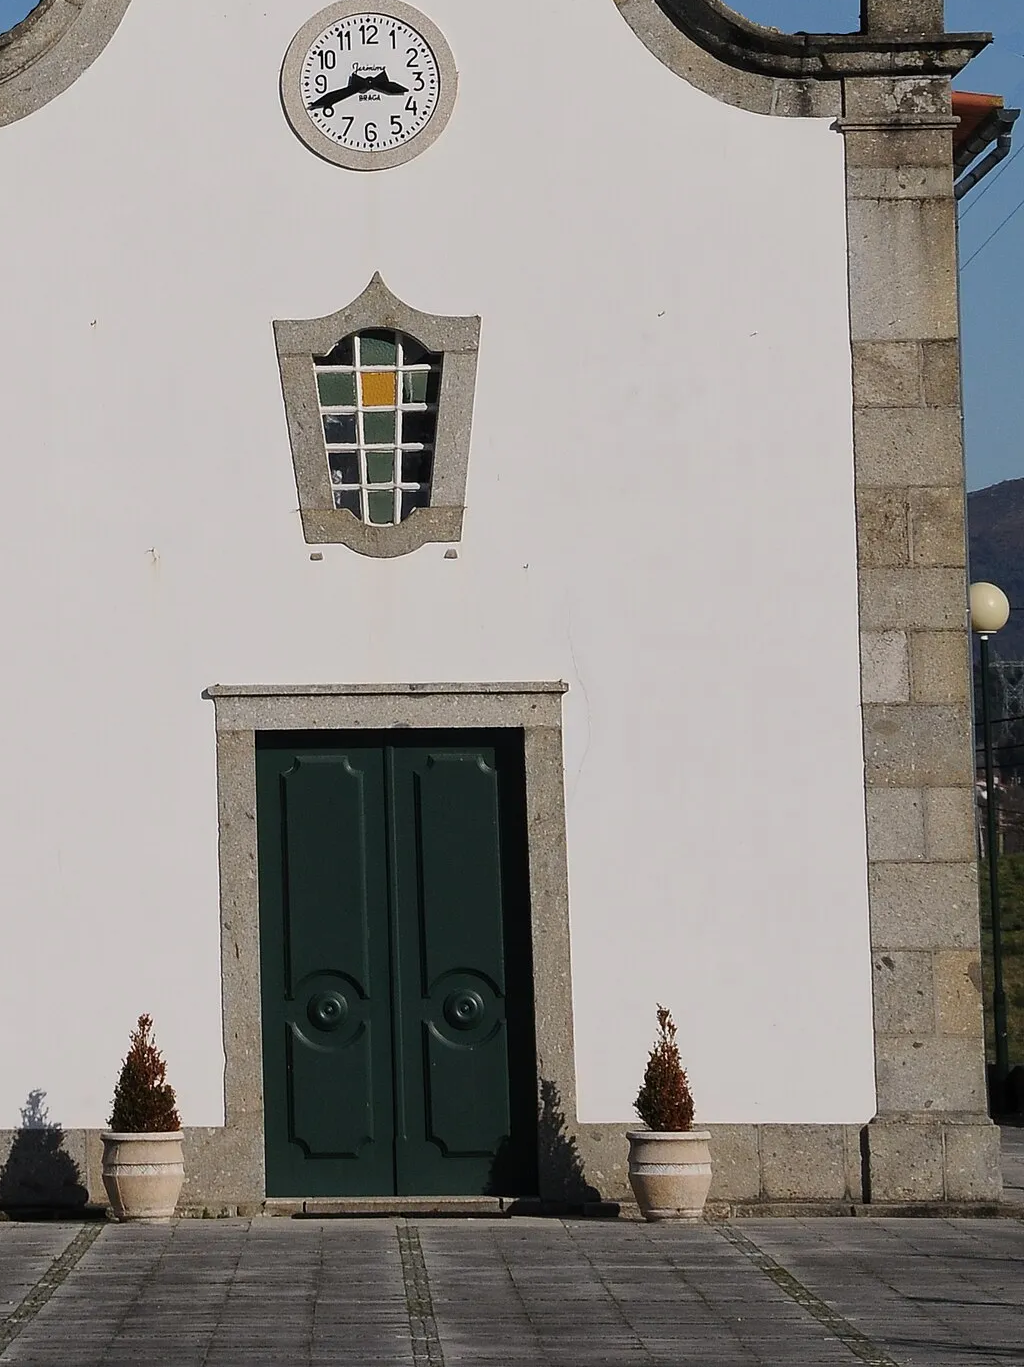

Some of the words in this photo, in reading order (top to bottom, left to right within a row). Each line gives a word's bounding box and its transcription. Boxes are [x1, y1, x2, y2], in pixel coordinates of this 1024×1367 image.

[337, 30, 351, 51] 11
[359, 25, 379, 45] 12
[389, 30, 396, 49] 1
[317, 50, 336, 70] 10
[406, 48, 419, 67] 2
[315, 74, 327, 94] 9
[412, 72, 425, 91] 3
[405, 96, 418, 116] 4
[342, 116, 355, 136] 7
[364, 122, 377, 142] 6
[390, 115, 403, 135] 5
